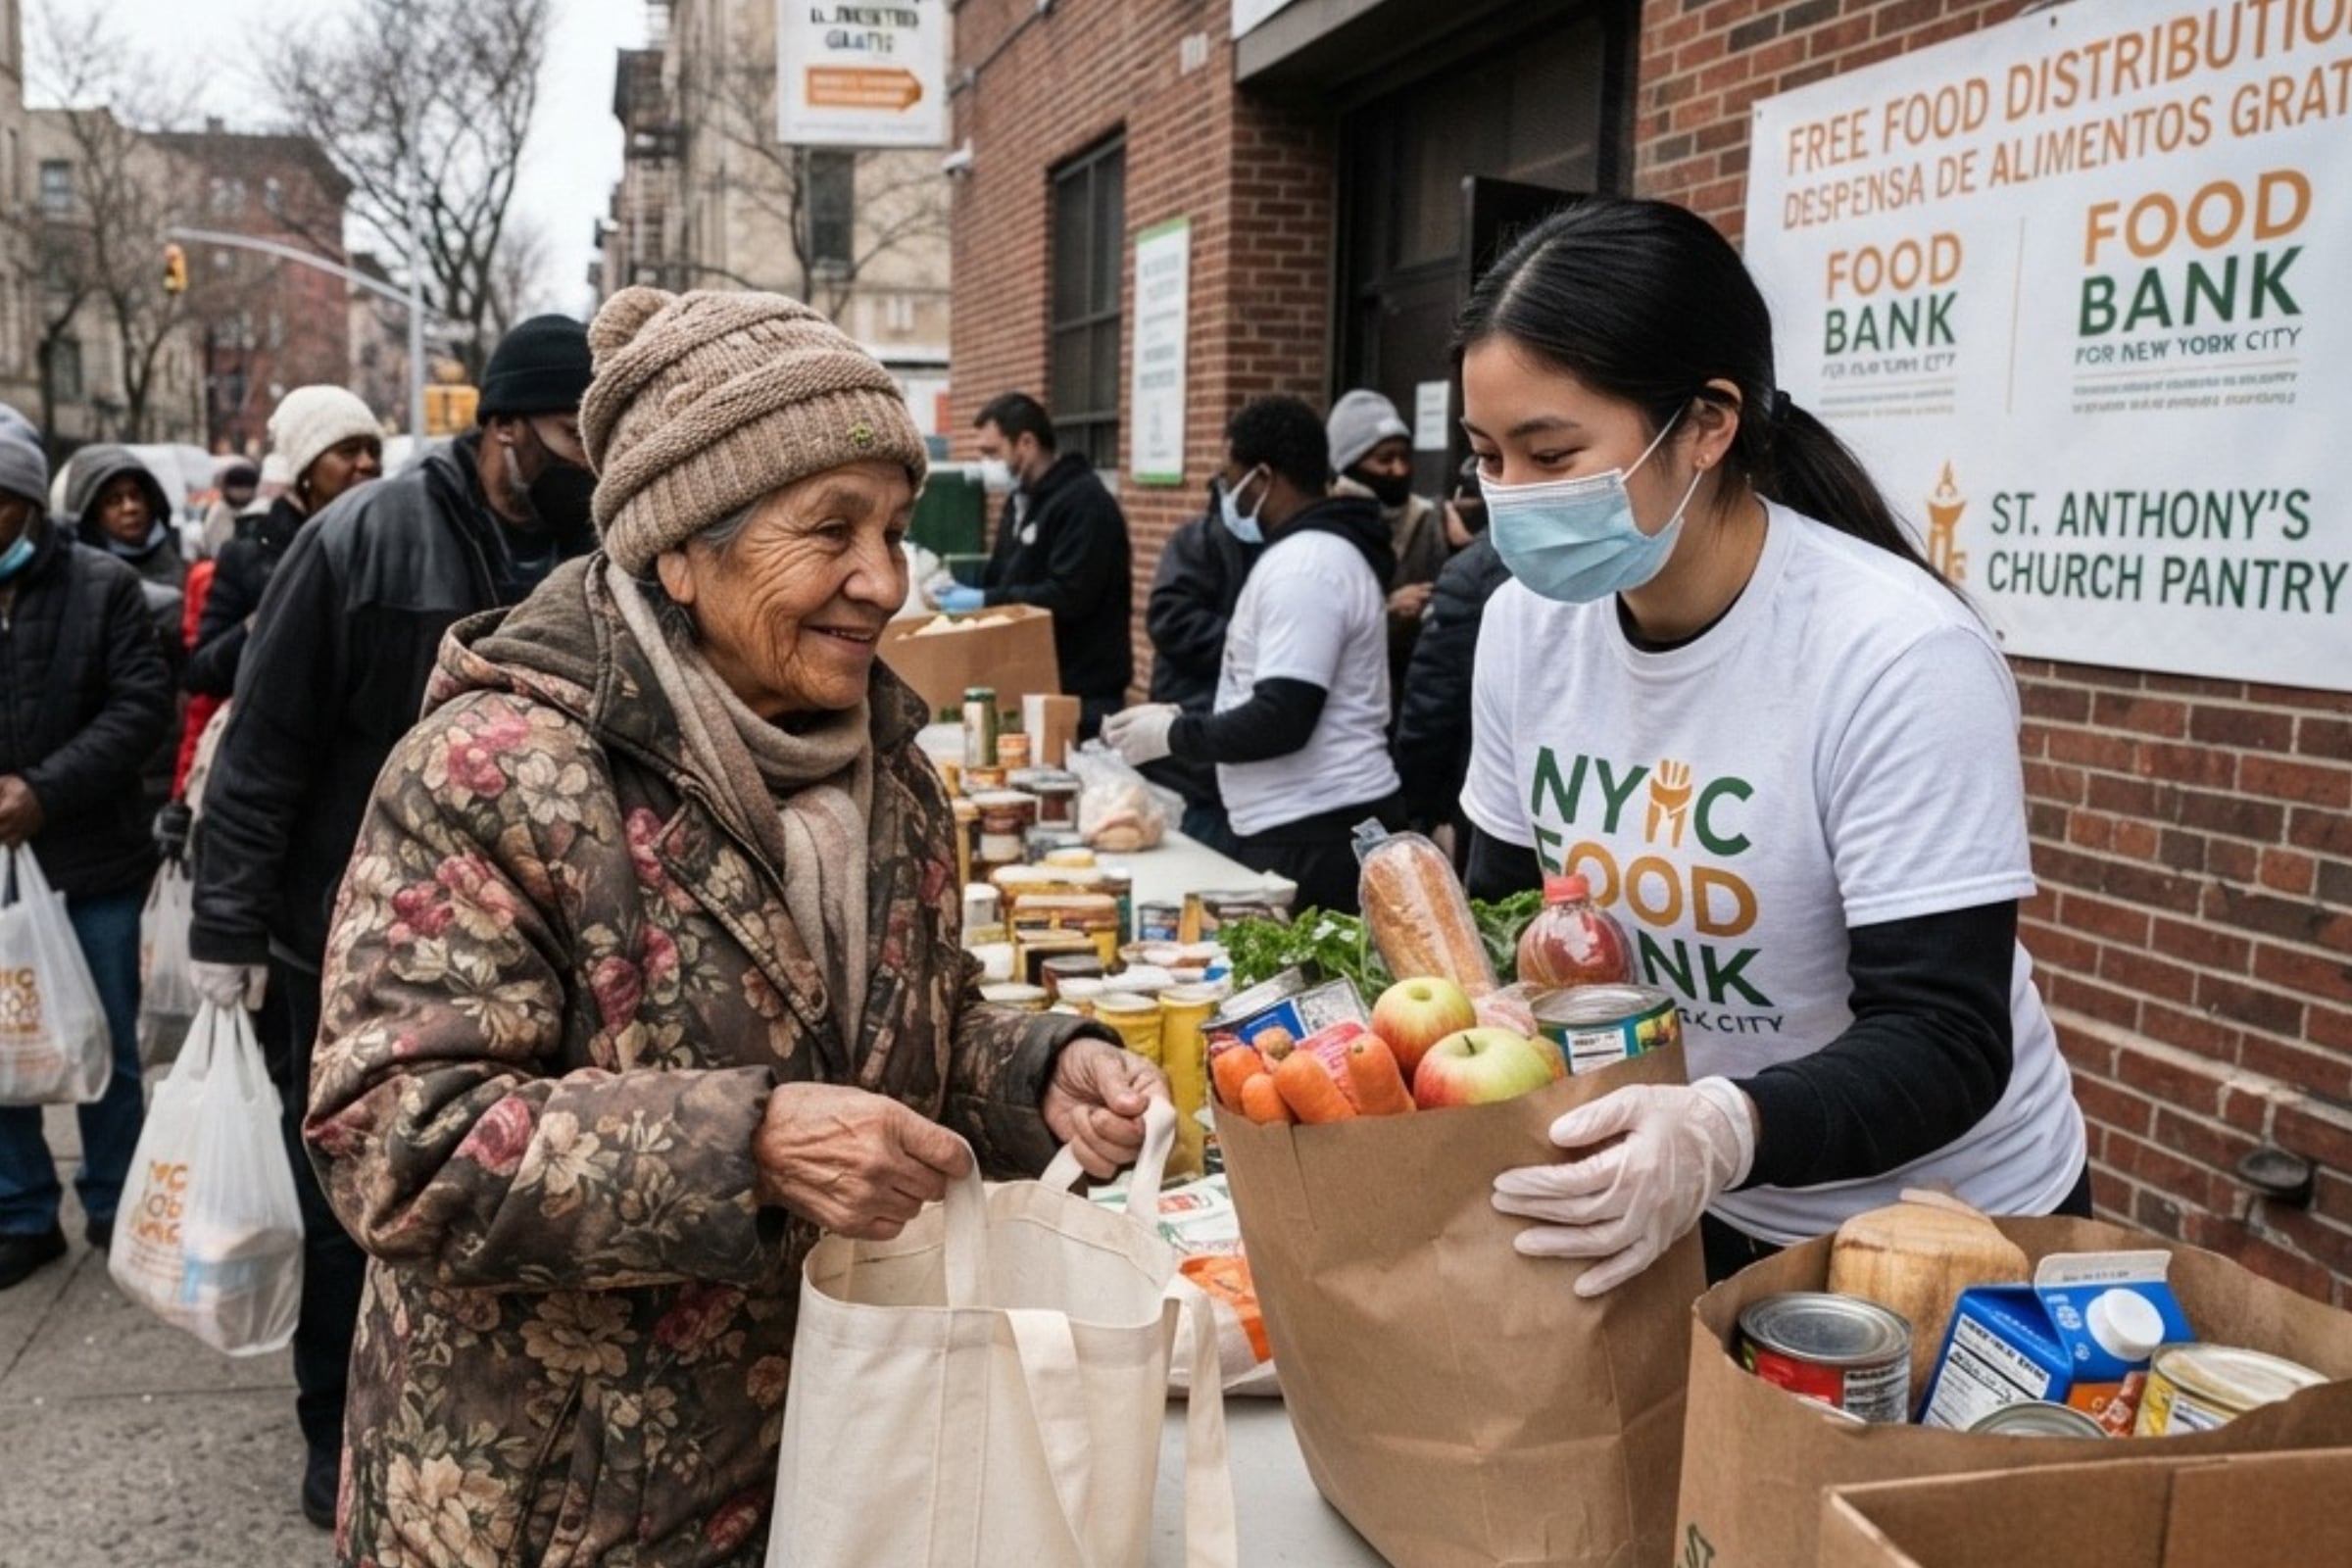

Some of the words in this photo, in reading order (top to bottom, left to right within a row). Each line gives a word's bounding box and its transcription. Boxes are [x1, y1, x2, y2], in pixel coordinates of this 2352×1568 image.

[1788, 108, 1870, 176] FREE
[1882, 77, 1989, 154] FOOD
[2005, 0, 2352, 122] DISTRIBUTIO
[1784, 162, 1925, 229] DESPENSA
[1936, 149, 1978, 198] DE
[1988, 95, 2211, 187] ALIMENTOS
[2084, 170, 2312, 267] FOOD
[1827, 232, 1962, 300] FOOD
[2079, 245, 2304, 337] BANK
[1825, 291, 1957, 356] BANK
[2122, 339, 2171, 362] NEW
[2178, 333, 2237, 355] YORK
[2246, 326, 2302, 351] CITY
[1990, 492, 2039, 536] ST.
[2056, 488, 2312, 541] ANTHONY'S
[1988, 551, 2143, 601] CHURCH
[2161, 556, 2350, 613] PANTRY
[1534, 823, 1757, 938] FOOD
[1638, 930, 1774, 1007] NK
[1718, 1014, 1784, 1034] CITY
